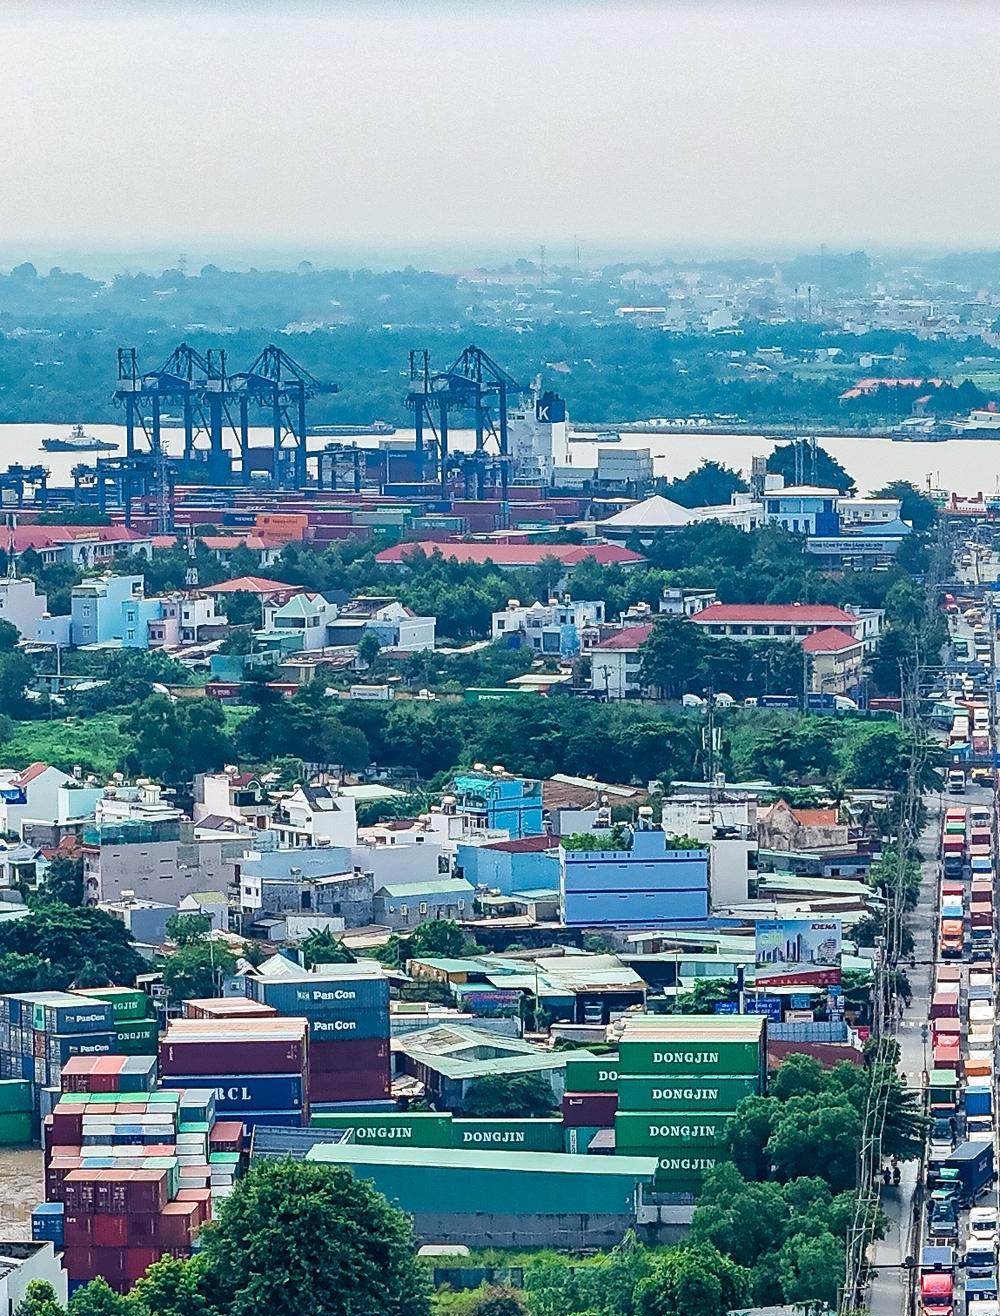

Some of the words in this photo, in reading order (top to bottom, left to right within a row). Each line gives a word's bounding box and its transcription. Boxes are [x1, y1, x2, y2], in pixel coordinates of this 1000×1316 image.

[539, 406, 549, 421] K
[313, 990, 356, 1000] PanCon
[76, 1014, 106, 1023] PanCon
[314, 1021, 356, 1031] PanCon
[80, 1044, 110, 1053] PanCon
[652, 1052, 719, 1063] DONGJIN
[652, 1088, 718, 1100] DONGJIN
[649, 1125, 716, 1137] DONGJIN
[463, 1131, 525, 1143] DONGJIN
